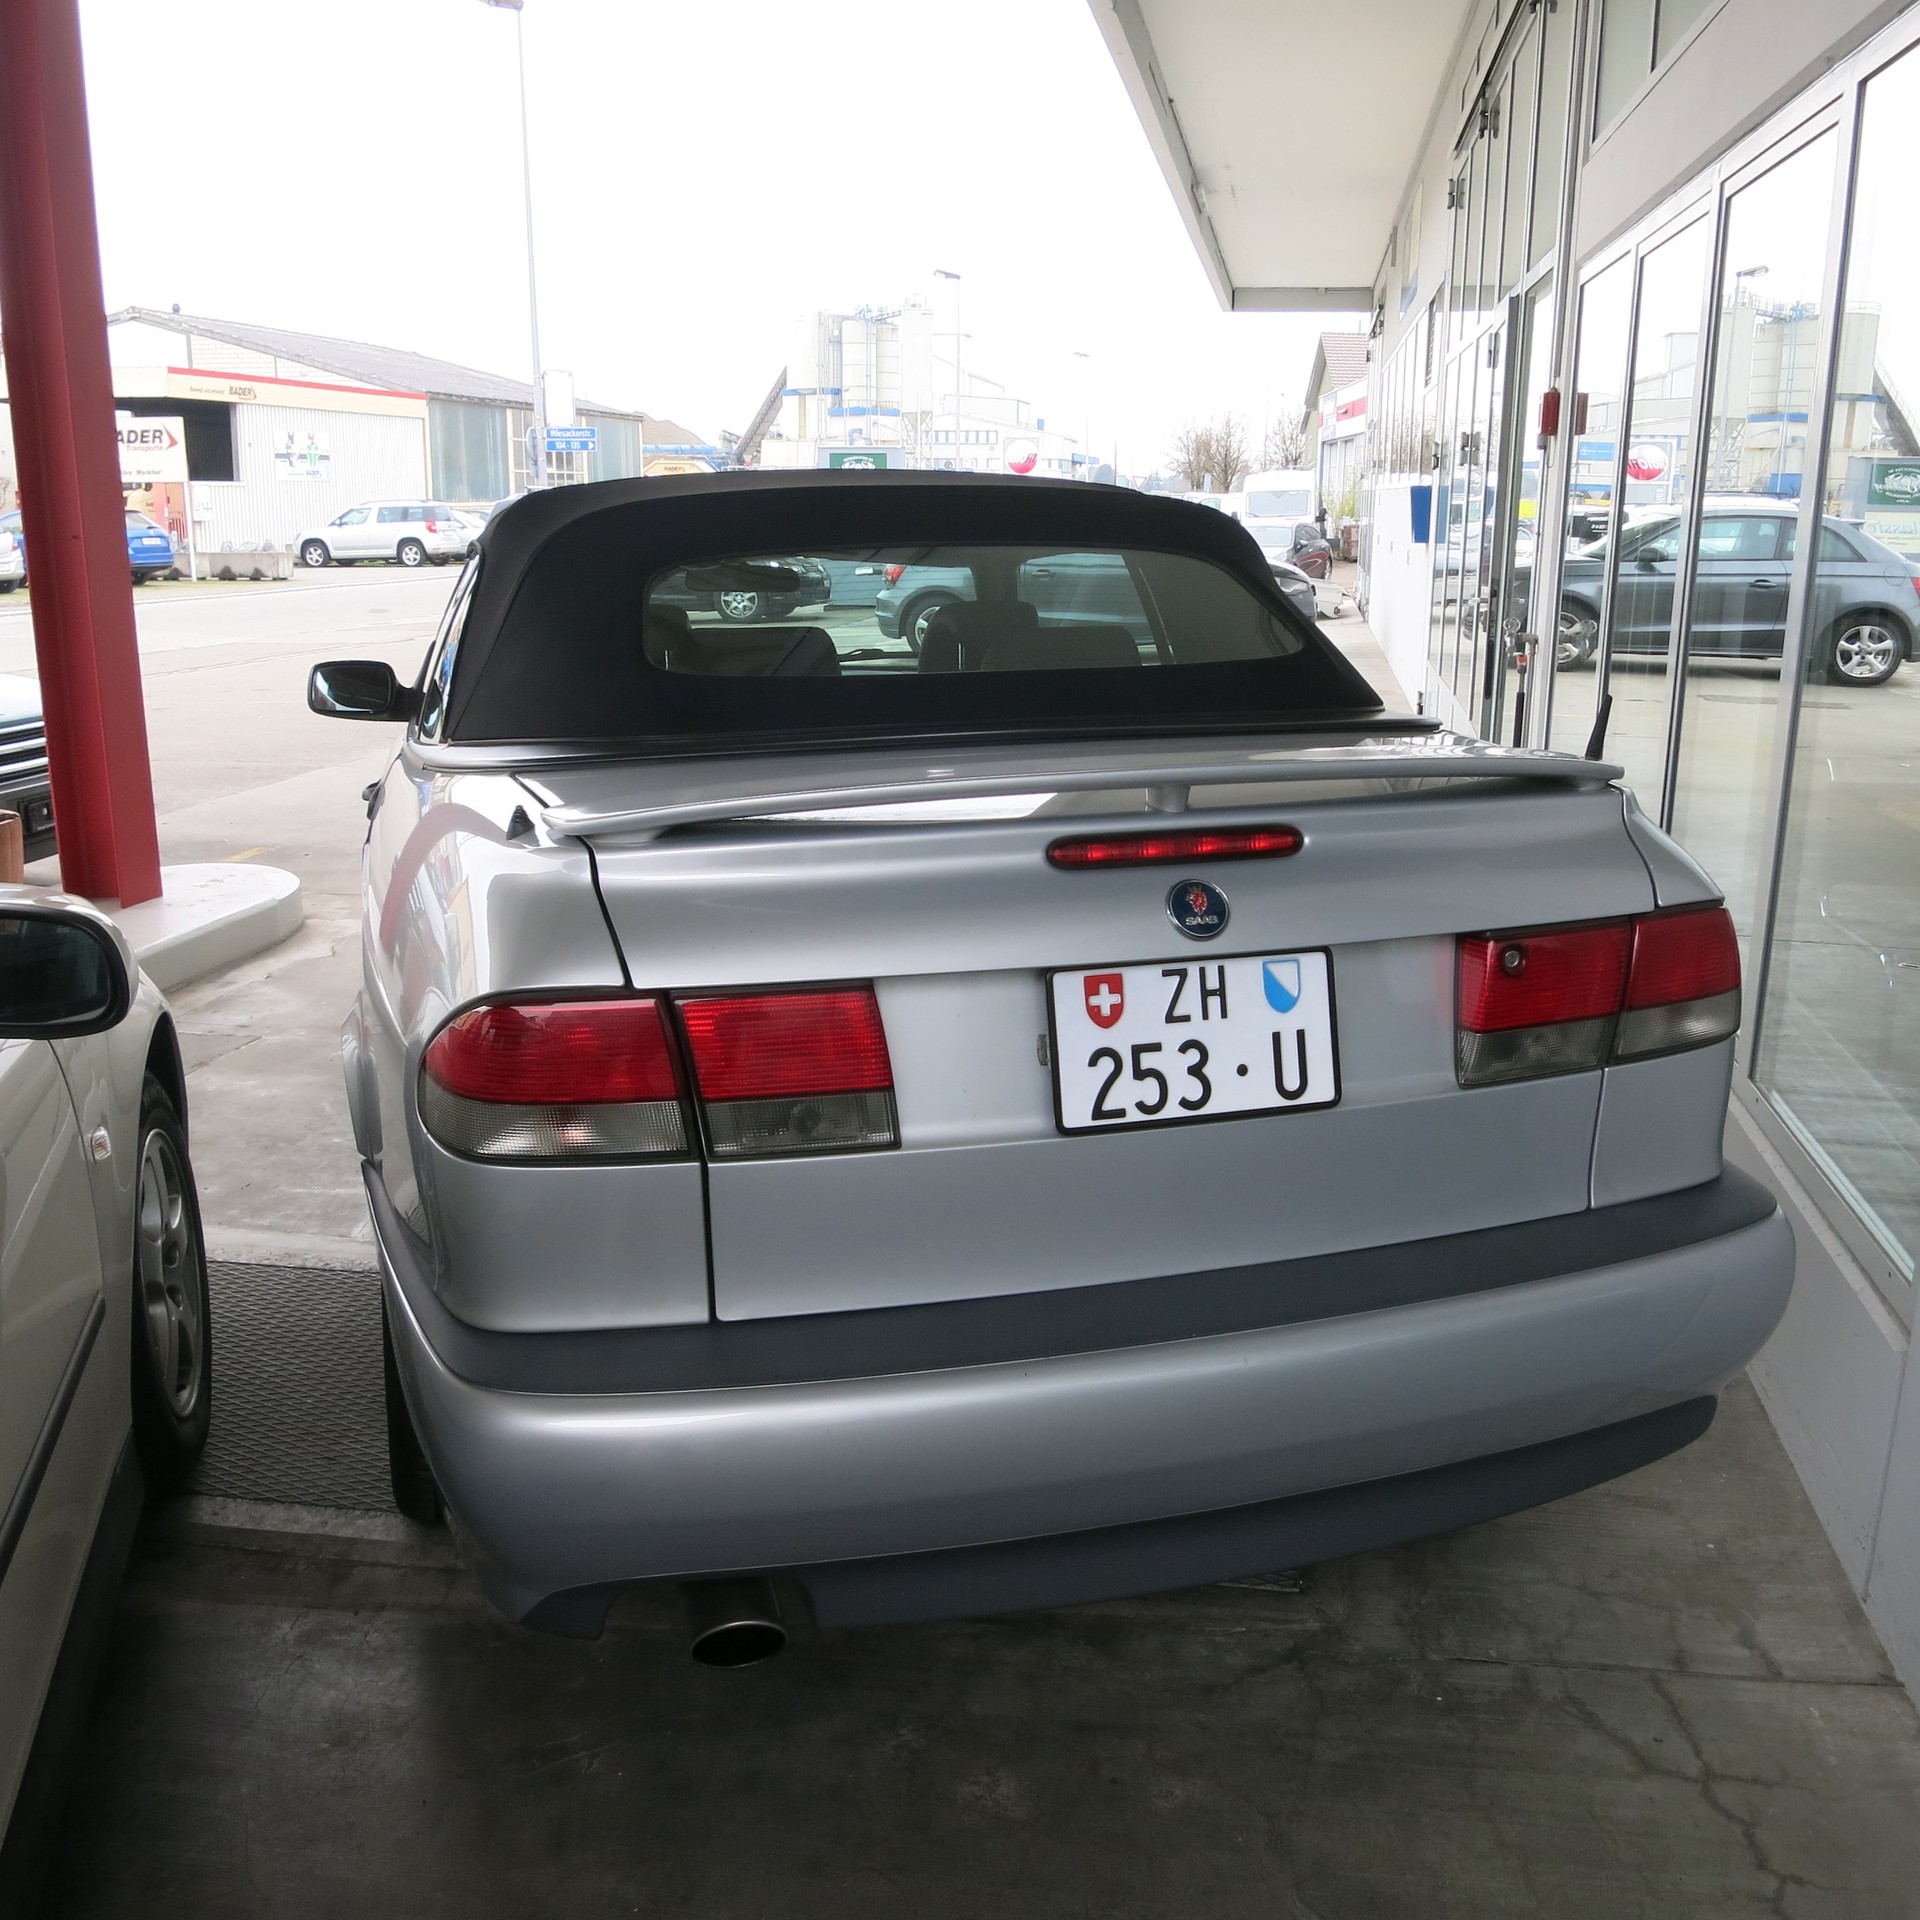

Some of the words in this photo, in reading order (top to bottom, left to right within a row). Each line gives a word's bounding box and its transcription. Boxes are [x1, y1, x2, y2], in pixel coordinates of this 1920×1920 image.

[229, 385, 252, 397] BADER
[117, 429, 164, 444] ADER
[550, 430, 593, 438] Wiesackerstr.
[1185, 915, 1219, 926] SAAB
[1161, 965, 1228, 1024] ZH
